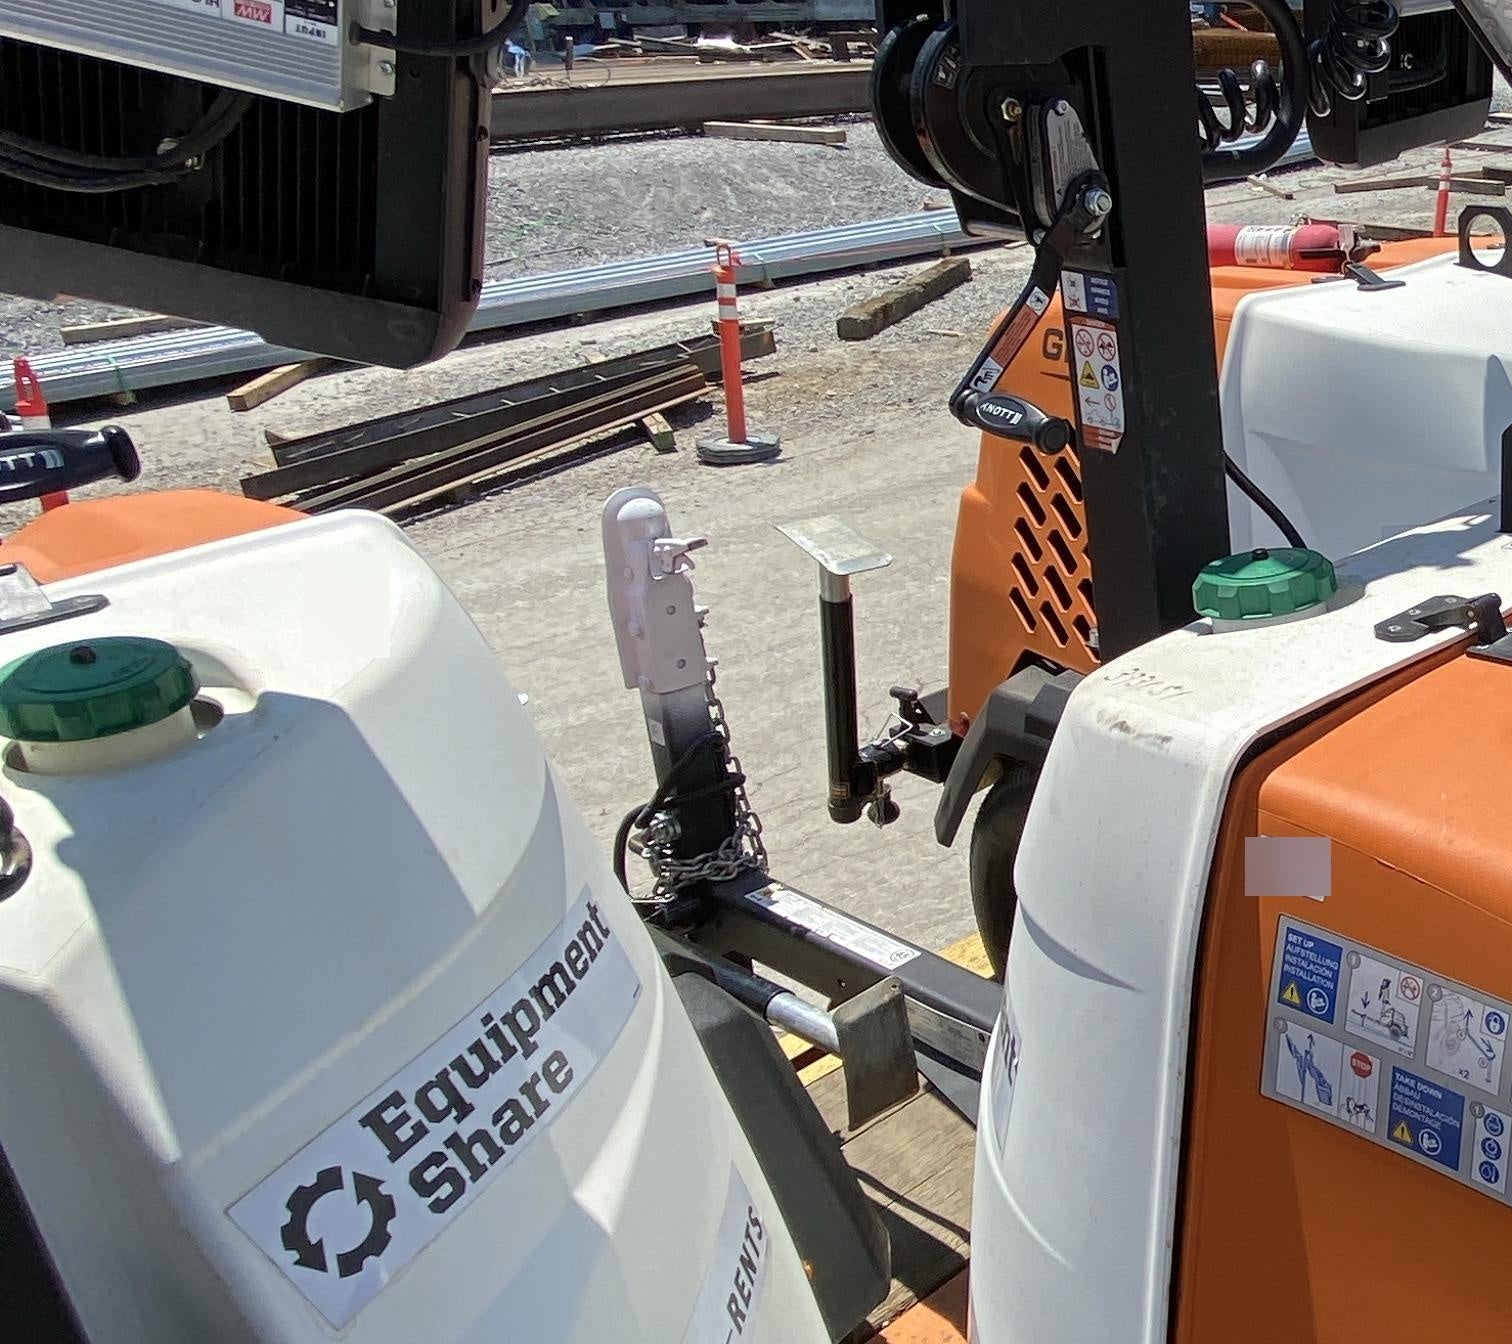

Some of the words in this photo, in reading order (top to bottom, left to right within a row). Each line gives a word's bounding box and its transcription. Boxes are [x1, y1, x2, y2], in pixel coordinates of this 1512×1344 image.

[1287, 932, 1302, 945] SET
[1303, 937, 1315, 948] UP
[357, 900, 611, 1164] Equipment
[1350, 1058, 1372, 1074] STOP
[408, 1049, 575, 1215] Share
